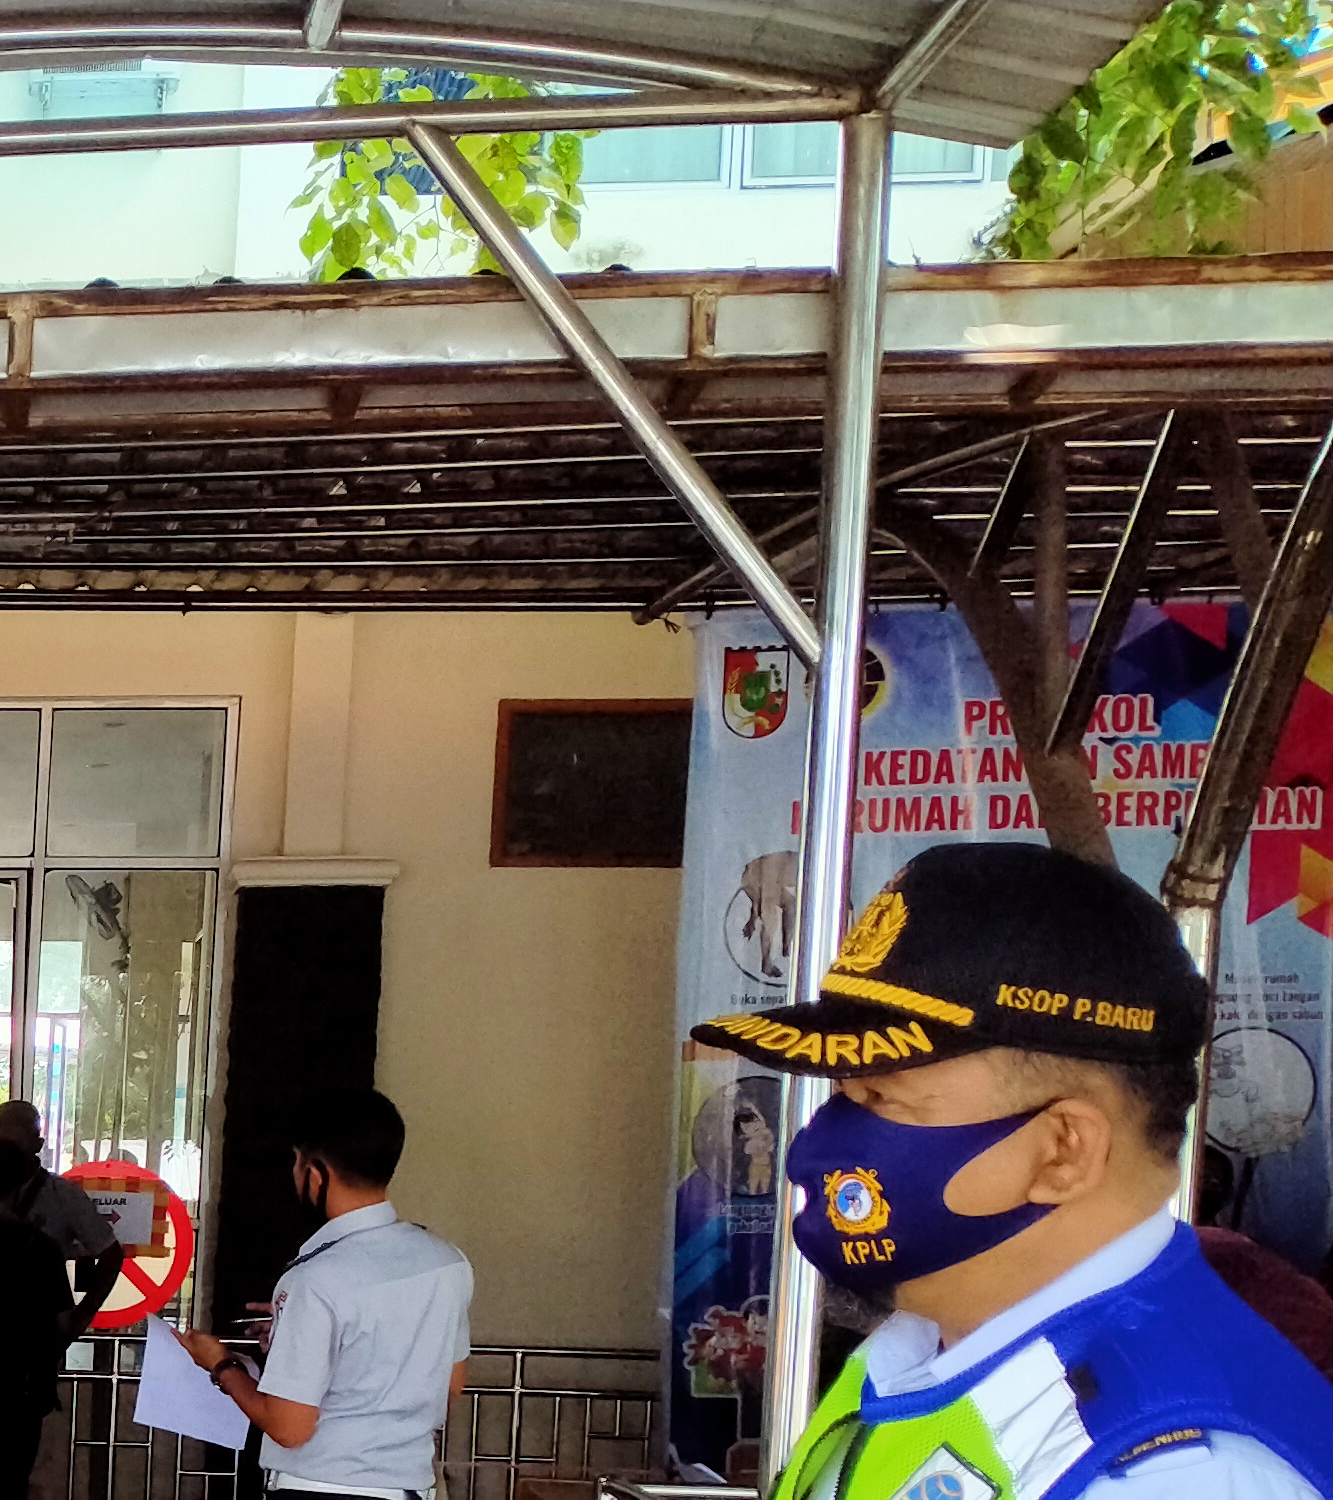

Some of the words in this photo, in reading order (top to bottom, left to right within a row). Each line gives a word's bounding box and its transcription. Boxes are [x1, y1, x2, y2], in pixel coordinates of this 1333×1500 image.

[995, 983, 1070, 1016] KSOP
[1073, 998, 1156, 1032] P.BARU
[841, 1237, 896, 1265] KPLP
